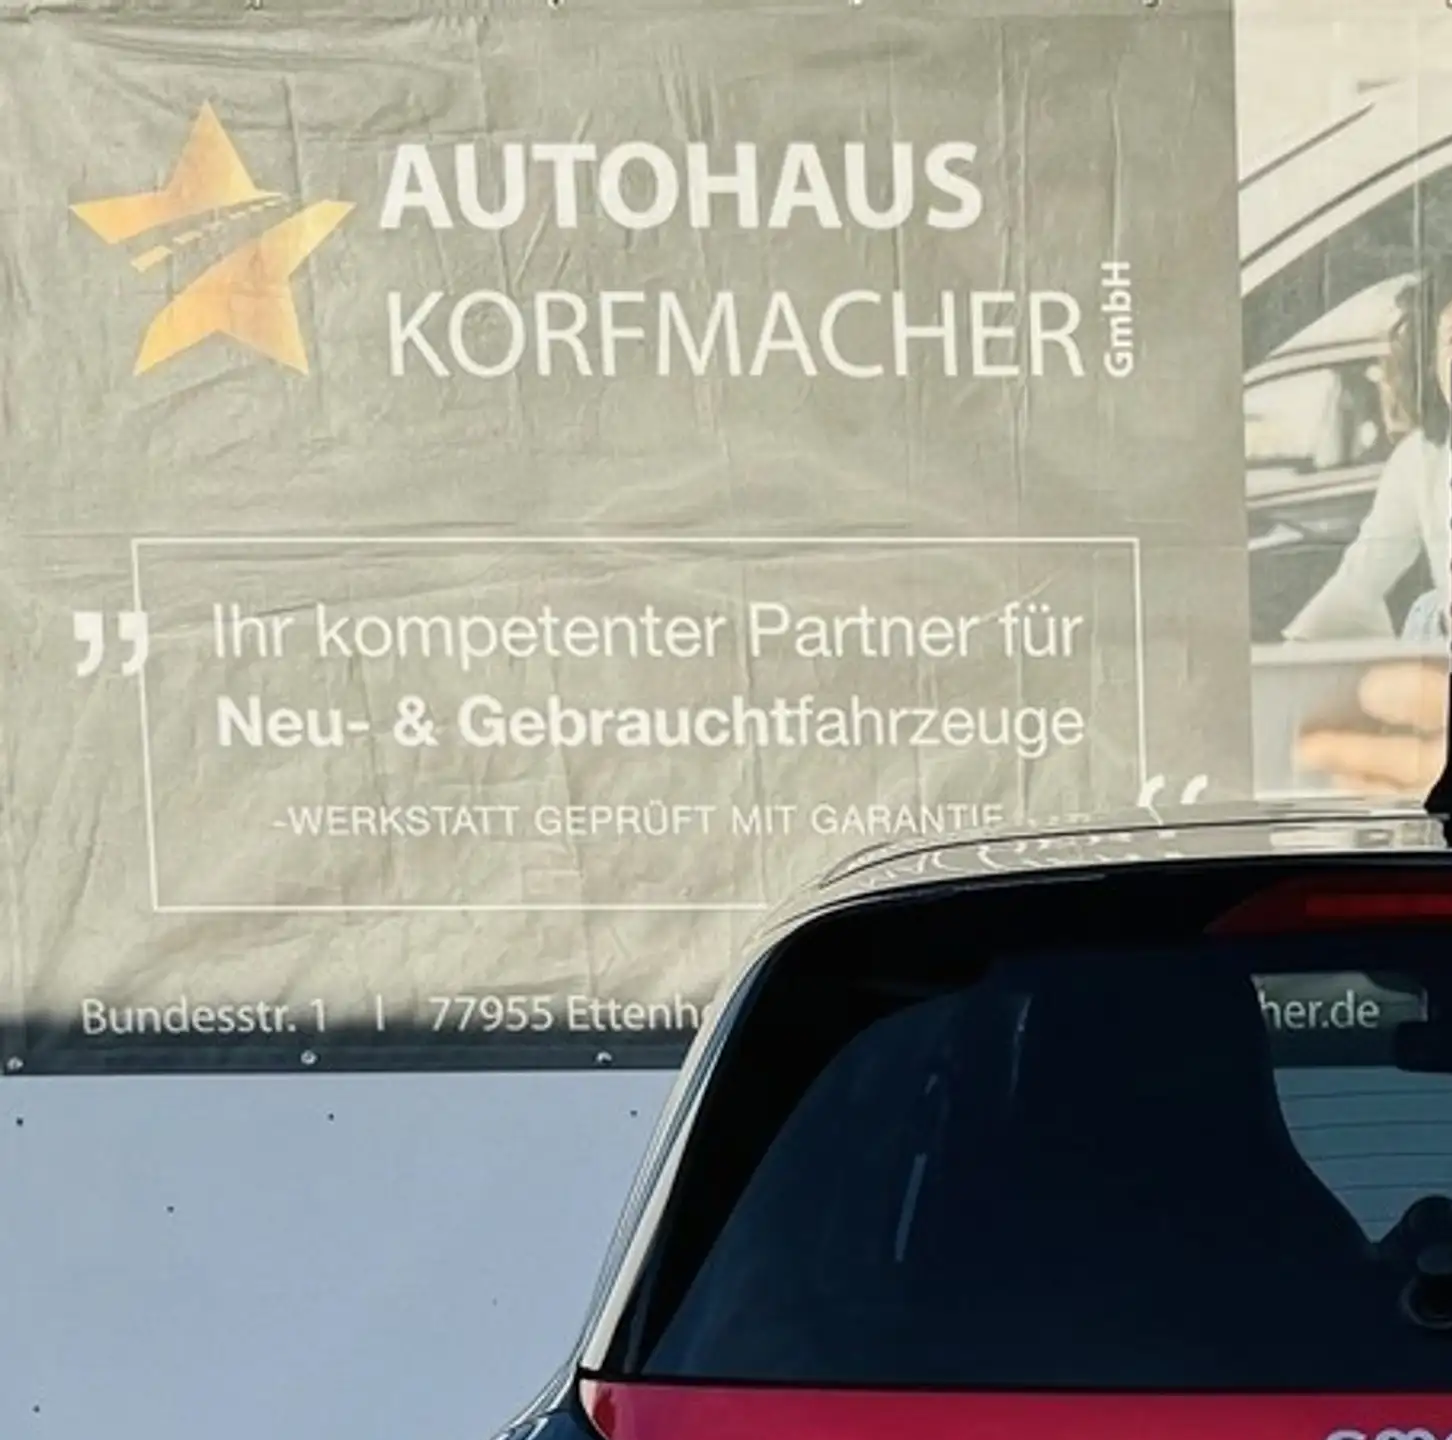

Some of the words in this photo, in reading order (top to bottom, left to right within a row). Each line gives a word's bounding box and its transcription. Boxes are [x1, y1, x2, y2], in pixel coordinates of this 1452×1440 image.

[379, 141, 984, 231] AUTOHAUS
[386, 288, 1086, 379] KORFMACHER
[1100, 260, 1135, 379] GmbH
[212, 602, 295, 659] Ihr
[314, 601, 726, 672] kompetenter
[749, 602, 981, 658] Partner
[997, 600, 1084, 658] für
[215, 695, 371, 748] Neu-
[392, 695, 439, 748] &
[457, 694, 1086, 760] Gebrauchtfahrzeuge
[272, 804, 520, 838] -WERKSTATT
[533, 799, 718, 836] GEPRÜFT
[731, 803, 798, 836] MIT
[82, 995, 297, 1035] Bundesstr.
[312, 995, 327, 1033] 1
[431, 993, 555, 1032] 77955
